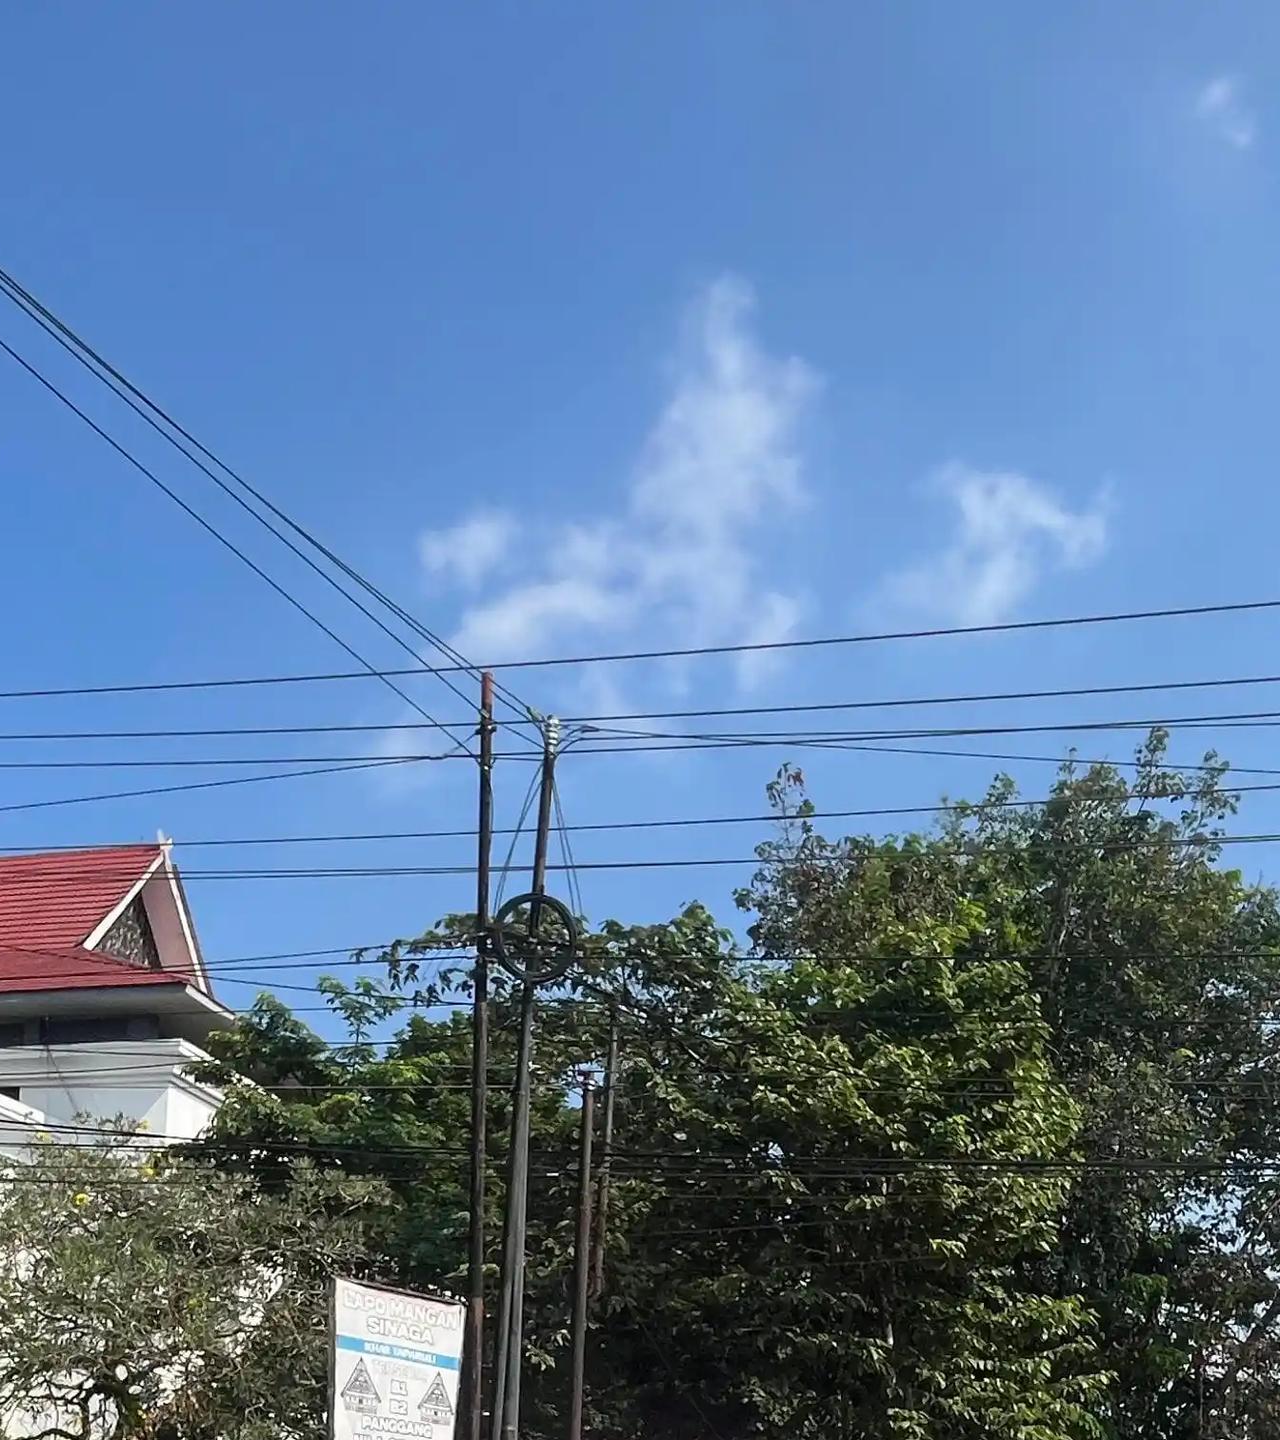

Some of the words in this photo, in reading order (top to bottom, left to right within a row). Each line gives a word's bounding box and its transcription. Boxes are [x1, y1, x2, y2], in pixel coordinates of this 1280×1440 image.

[389, 1299, 458, 1330] MANGAN
[366, 1315, 434, 1345] SINAGA
[361, 1415, 433, 1439] PANGGANG
